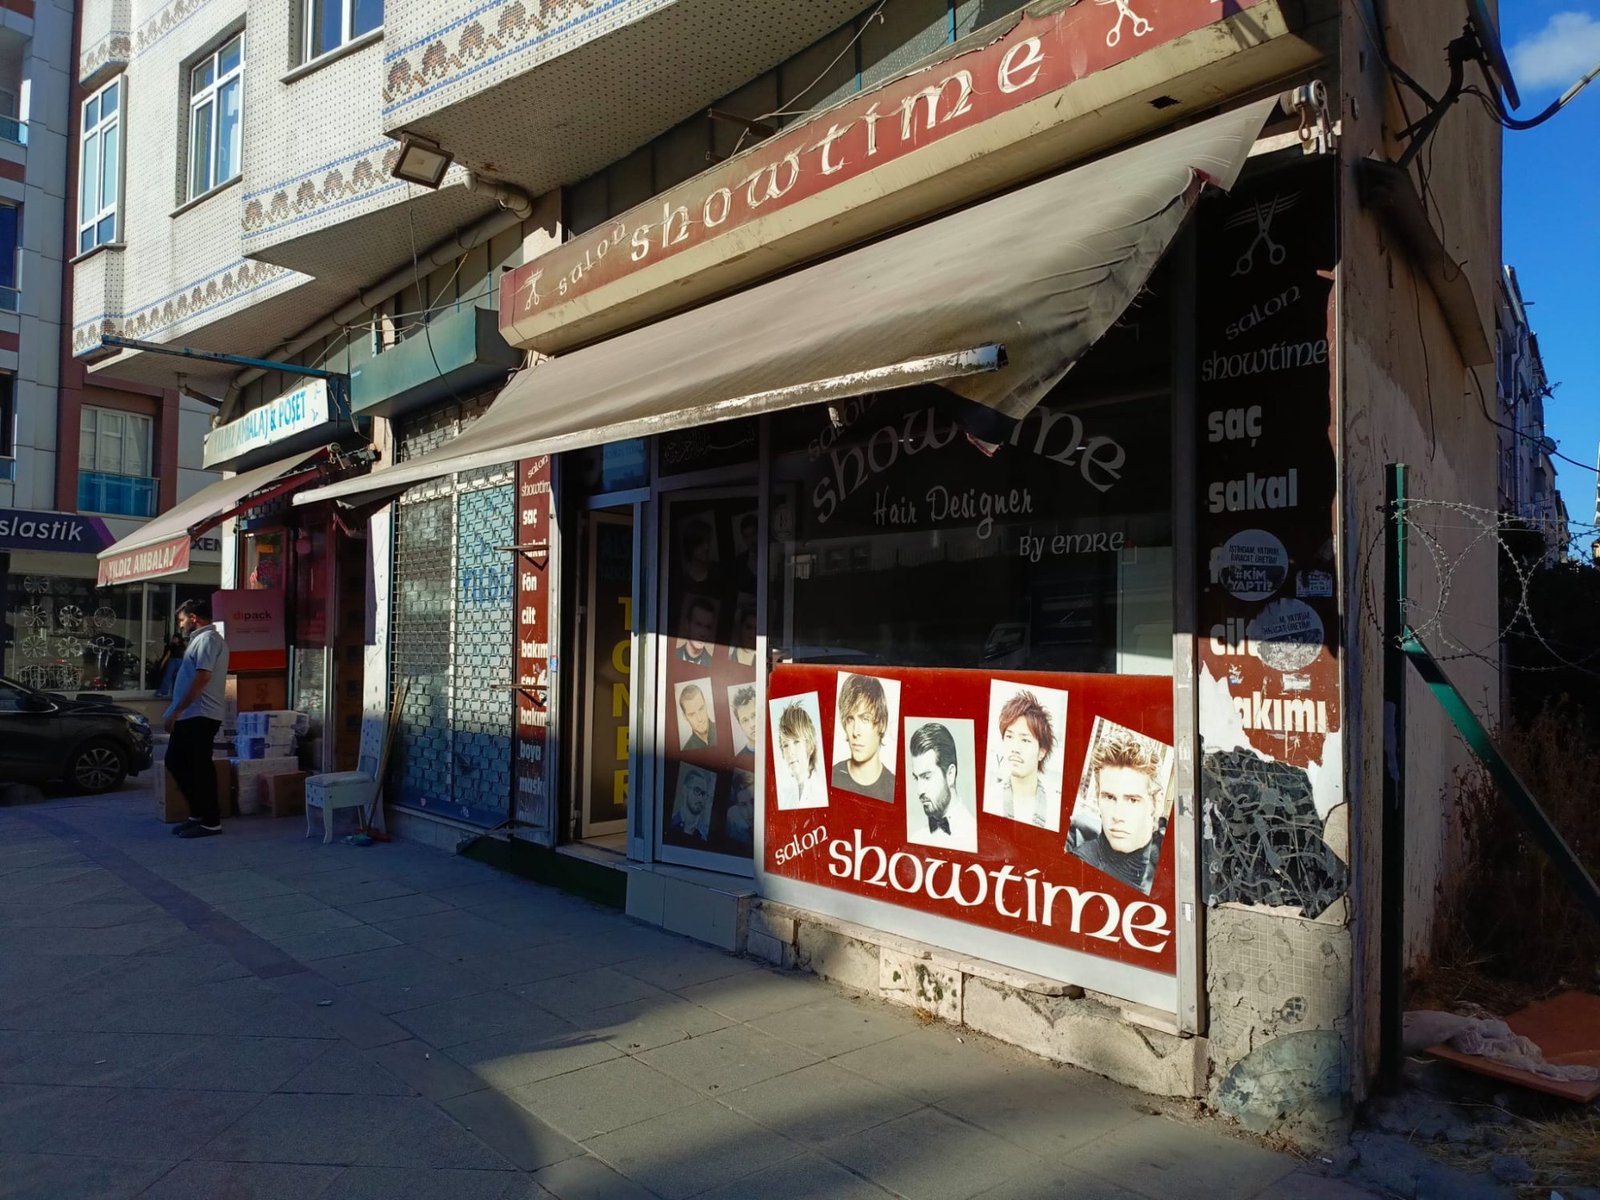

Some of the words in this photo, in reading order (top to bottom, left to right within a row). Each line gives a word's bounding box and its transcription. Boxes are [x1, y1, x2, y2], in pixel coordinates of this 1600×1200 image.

[558, 221, 628, 297] salon
[630, 37, 1045, 262] showtime
[1225, 284, 1301, 342] salon
[1202, 338, 1327, 382] showtime
[270, 412, 277, 432] &
[279, 391, 308, 430] POŞET
[1208, 404, 1262, 447] saç
[527, 455, 549, 479] salon
[1208, 468, 1298, 513] sakal
[0, 516, 83, 542] slastik
[522, 508, 538, 528] saç
[873, 485, 917, 528] Hair
[926, 485, 1034, 540] Designer
[108, 559, 131, 579] YILDIZ
[133, 546, 177, 574] AMBALAJ
[1018, 534, 1045, 563] By
[521, 571, 538, 591] fön
[233, 610, 273, 622] dipack
[521, 606, 537, 625] cilt
[1233, 691, 1327, 734] akımı
[519, 739, 542, 763] boya
[775, 824, 828, 866] salon
[828, 828, 1172, 953] showtime
